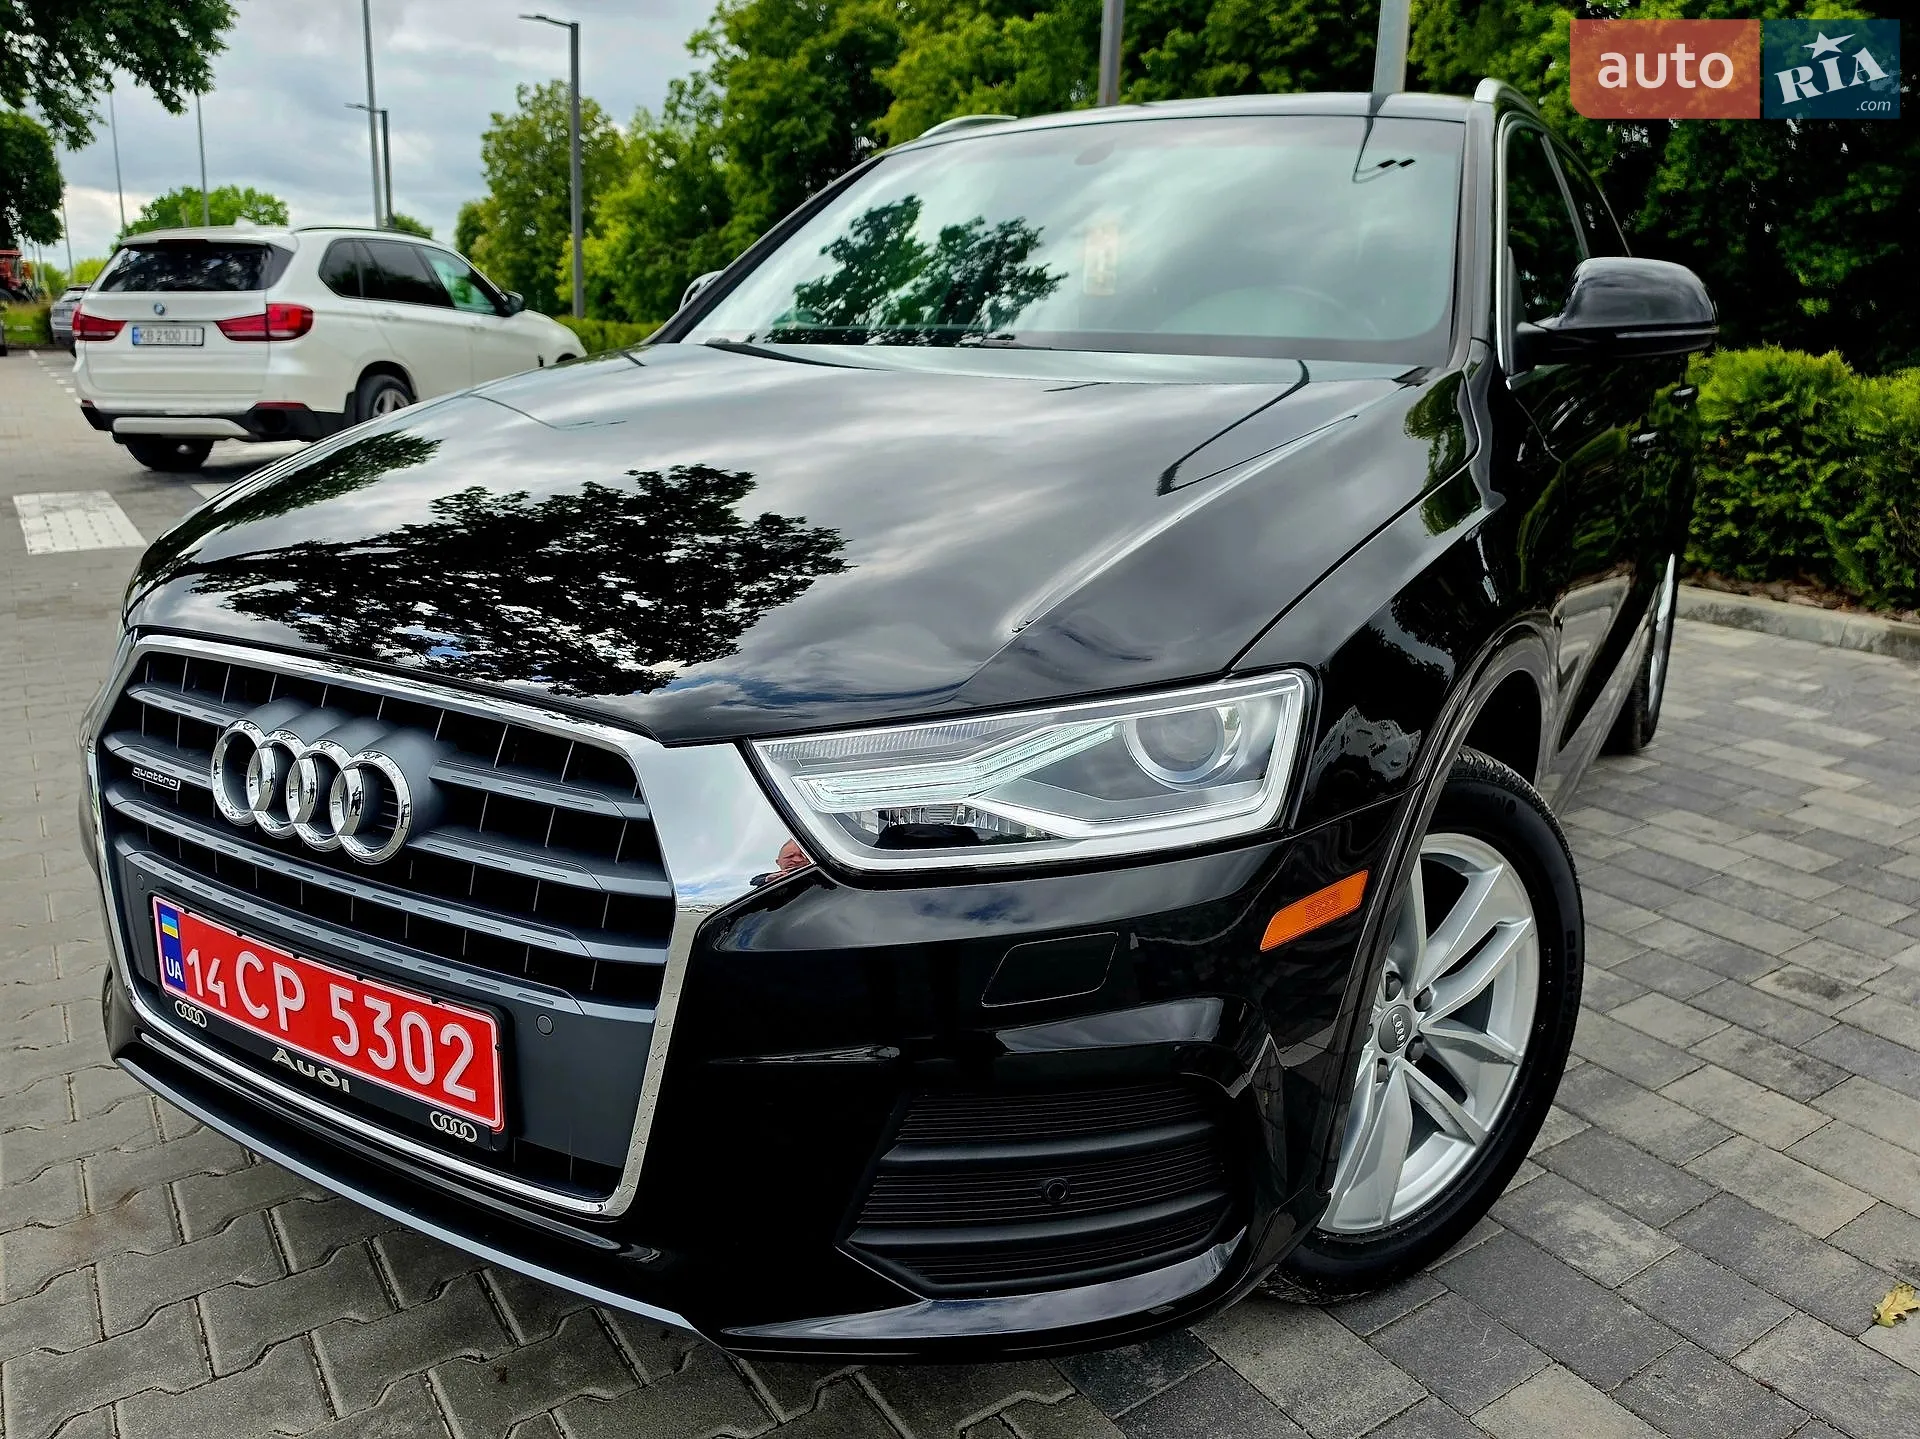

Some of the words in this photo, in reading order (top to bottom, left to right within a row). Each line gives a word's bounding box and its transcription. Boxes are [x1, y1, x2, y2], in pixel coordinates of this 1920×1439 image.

[133, 766, 177, 789] quattro
[166, 956, 184, 983] UA
[329, 983, 477, 1103] 5302
[271, 1047, 351, 1094] Audi
